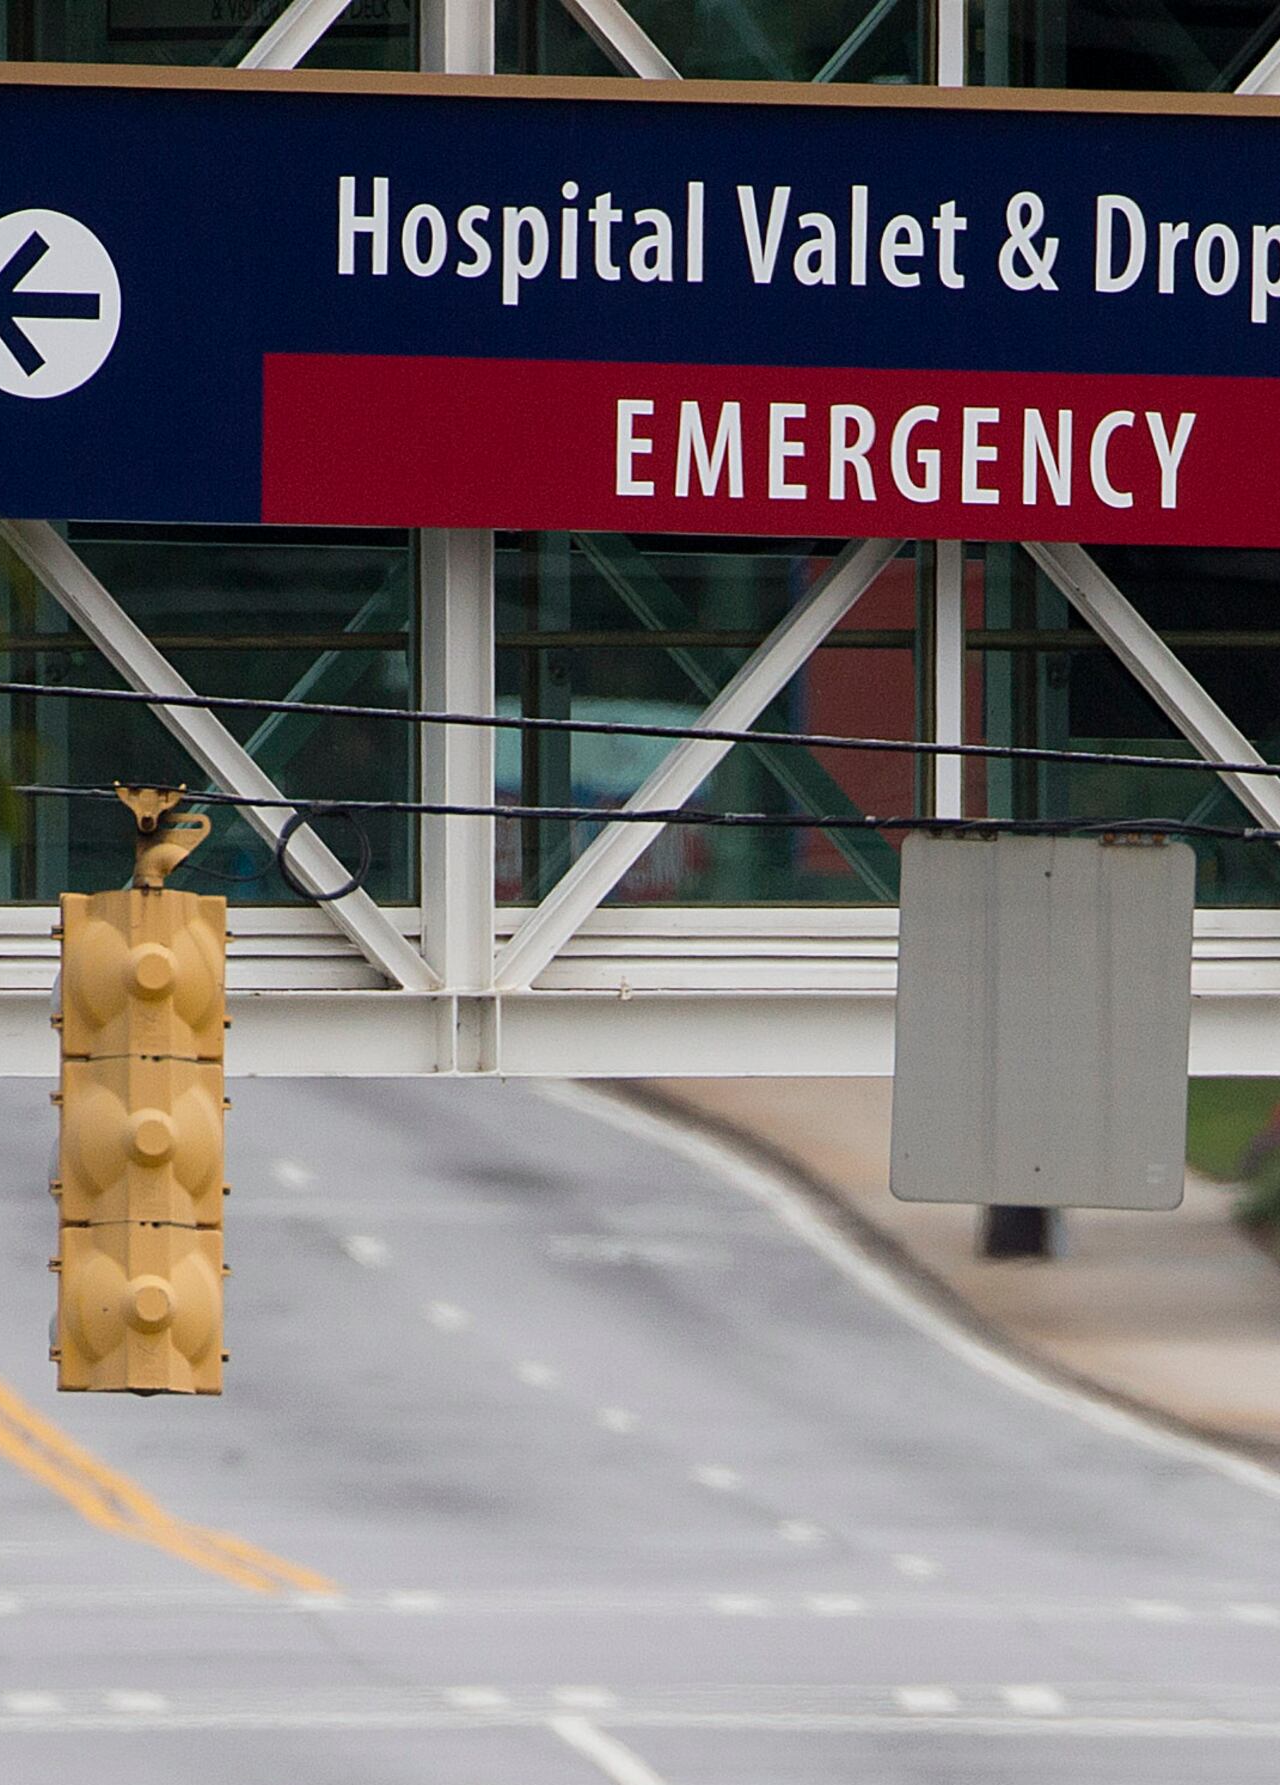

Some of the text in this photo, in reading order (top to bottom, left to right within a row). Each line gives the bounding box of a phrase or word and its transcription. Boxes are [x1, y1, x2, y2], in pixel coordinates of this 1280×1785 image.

[338, 176, 704, 306] Hospital
[736, 185, 968, 289] Valet
[998, 191, 1060, 292] &
[615, 399, 1197, 509] EMERGENCY
